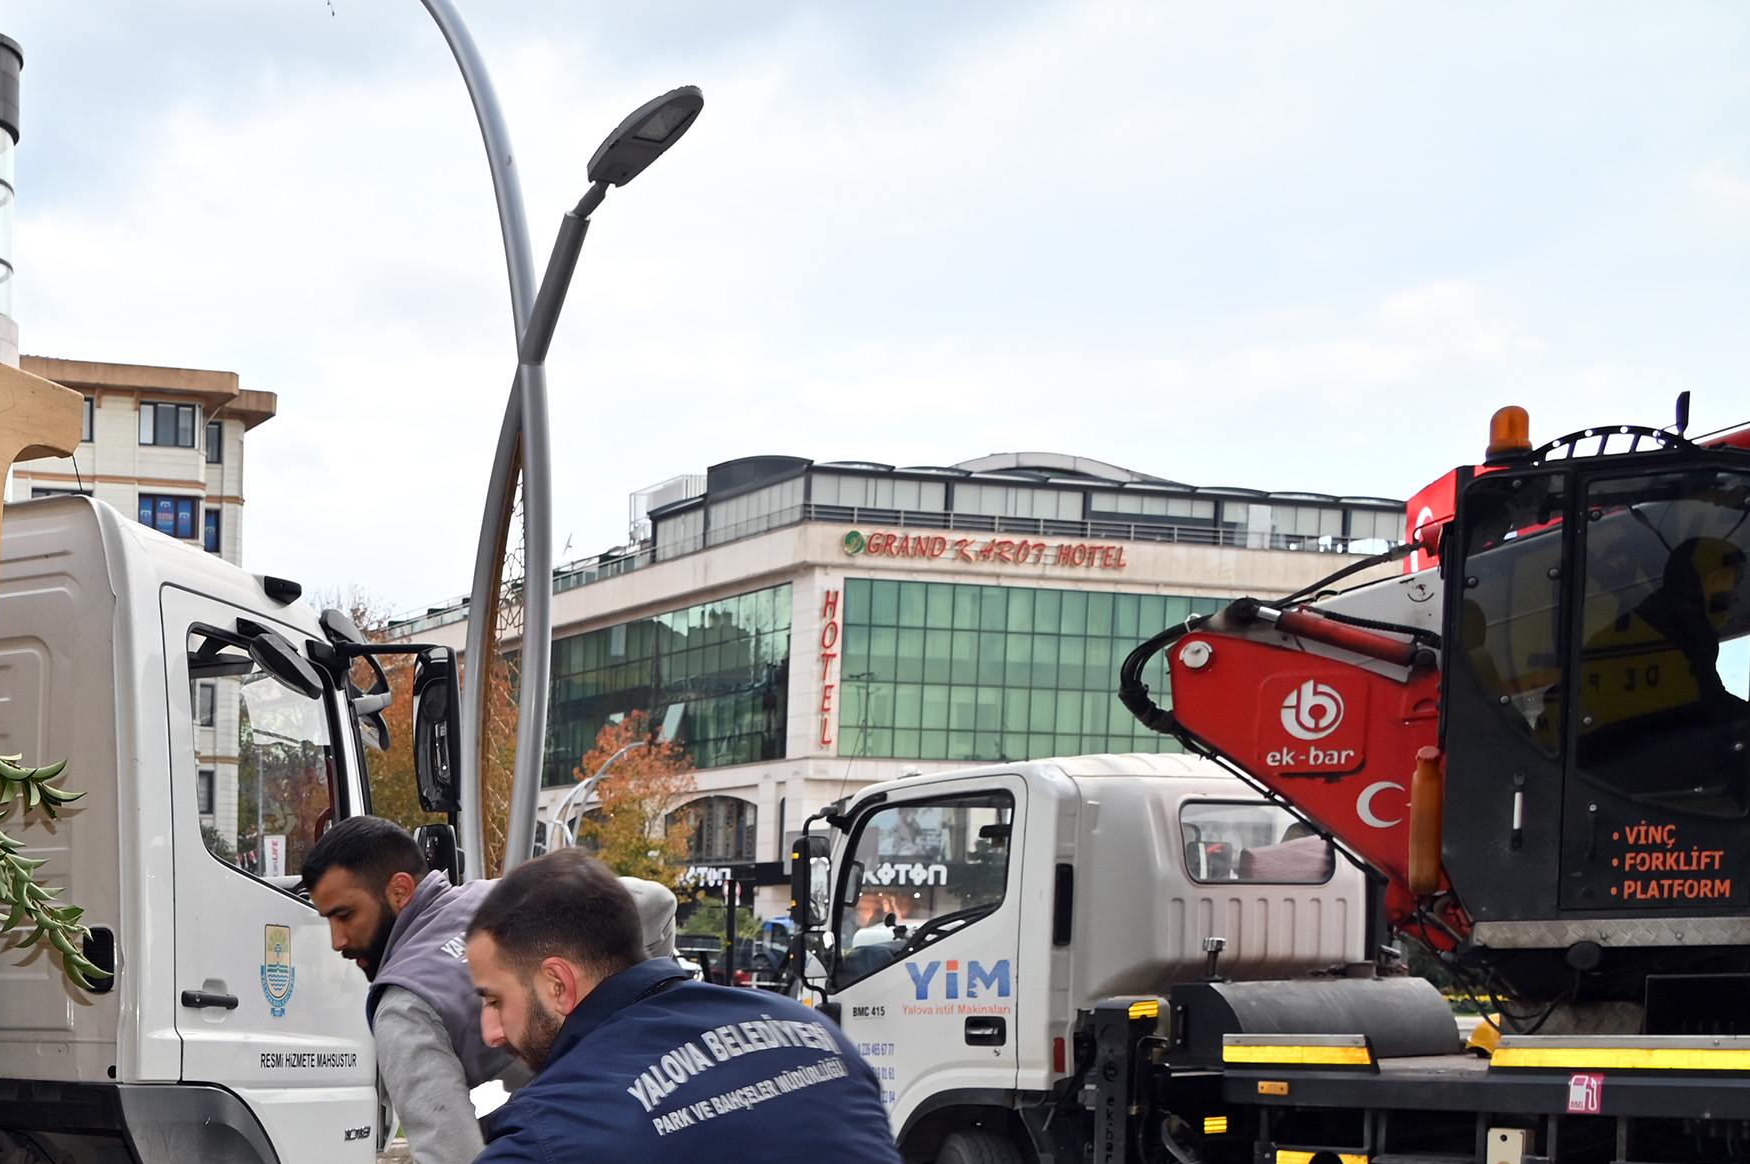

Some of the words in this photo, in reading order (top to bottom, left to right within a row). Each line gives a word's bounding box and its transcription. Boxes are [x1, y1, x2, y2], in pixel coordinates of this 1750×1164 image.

[866, 531, 947, 559] GRAND
[1056, 543, 1128, 569] HOTEL
[820, 589, 840, 748] HOTEL
[1265, 744, 1356, 768] ek-bar
[1624, 820, 1678, 850] VİNÇ
[1624, 847, 1725, 873] FORKLİFT
[1623, 878, 1732, 900] PLATFORM
[852, 1006, 870, 1017] BMC
[871, 1006, 886, 1017] 415
[902, 1005, 934, 1016] Yalova
[957, 1004, 1011, 1015] Makinaları
[316, 1053, 358, 1068] MAHSUSTUR
[627, 1041, 716, 1113] YALOVA
[700, 1014, 843, 1062] BELEDİYESİ
[652, 1108, 698, 1136] PARK
[690, 1101, 718, 1121] VE
[710, 1079, 780, 1115] BAHÇELER
[777, 1056, 850, 1095] MÜDÜRLÜĞÜ
